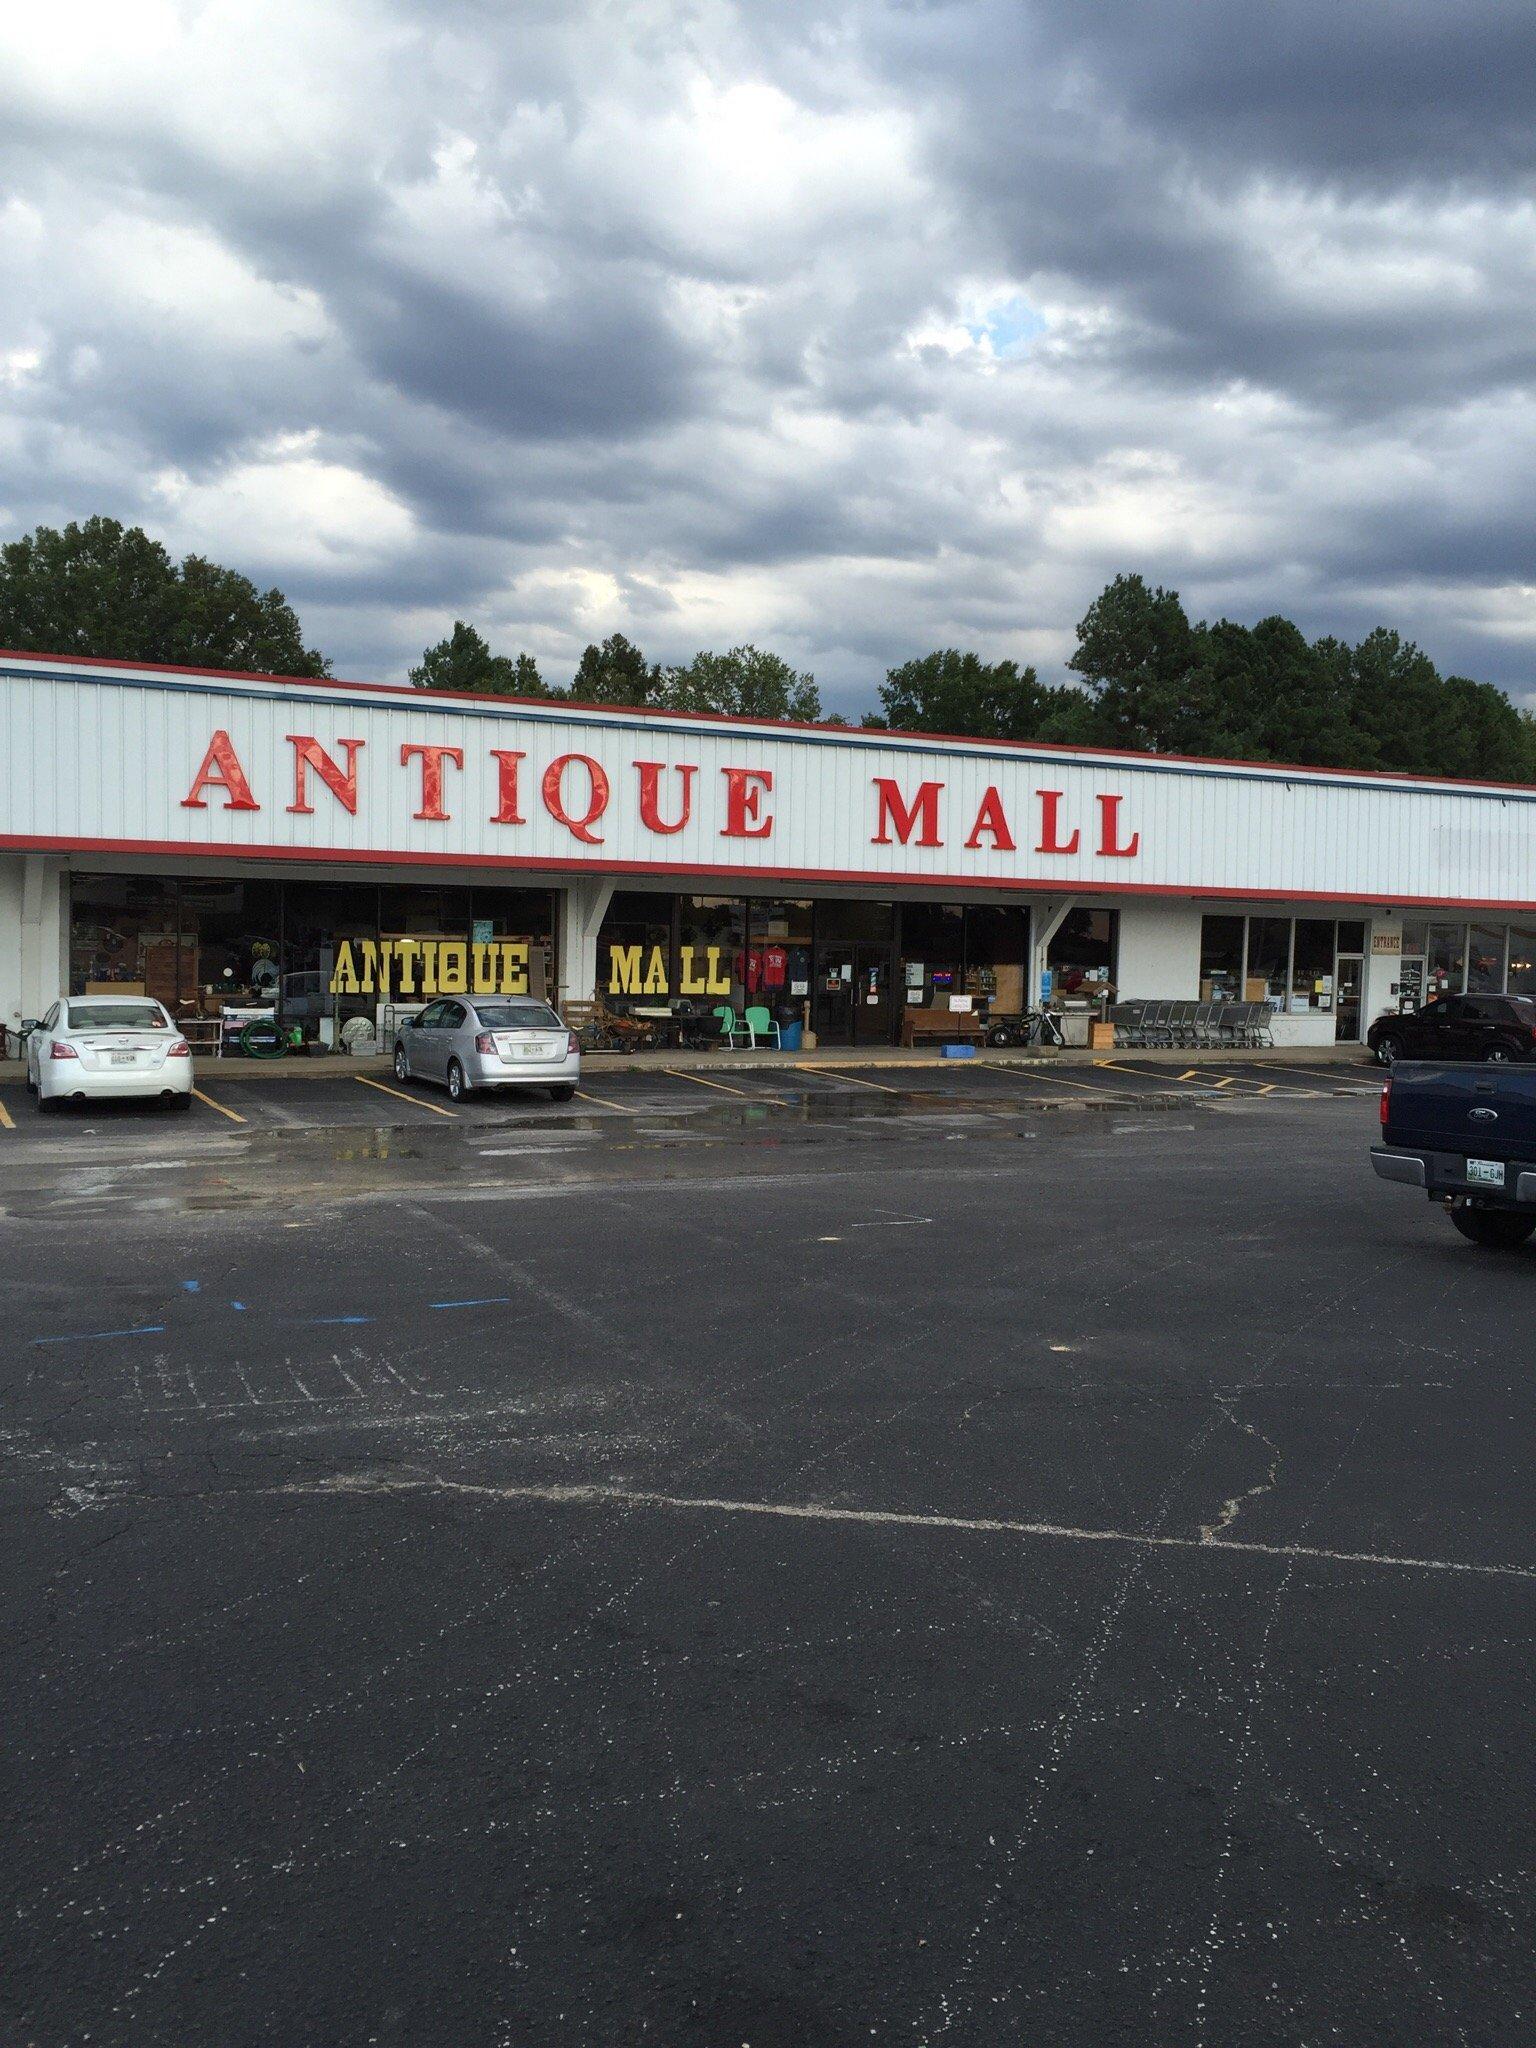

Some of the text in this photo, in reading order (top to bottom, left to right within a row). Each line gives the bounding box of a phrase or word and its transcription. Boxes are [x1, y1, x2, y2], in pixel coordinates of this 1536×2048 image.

[180, 730, 1139, 857] ANTIQUE MALL
[330, 940, 731, 995] ANTIQUE MALL
